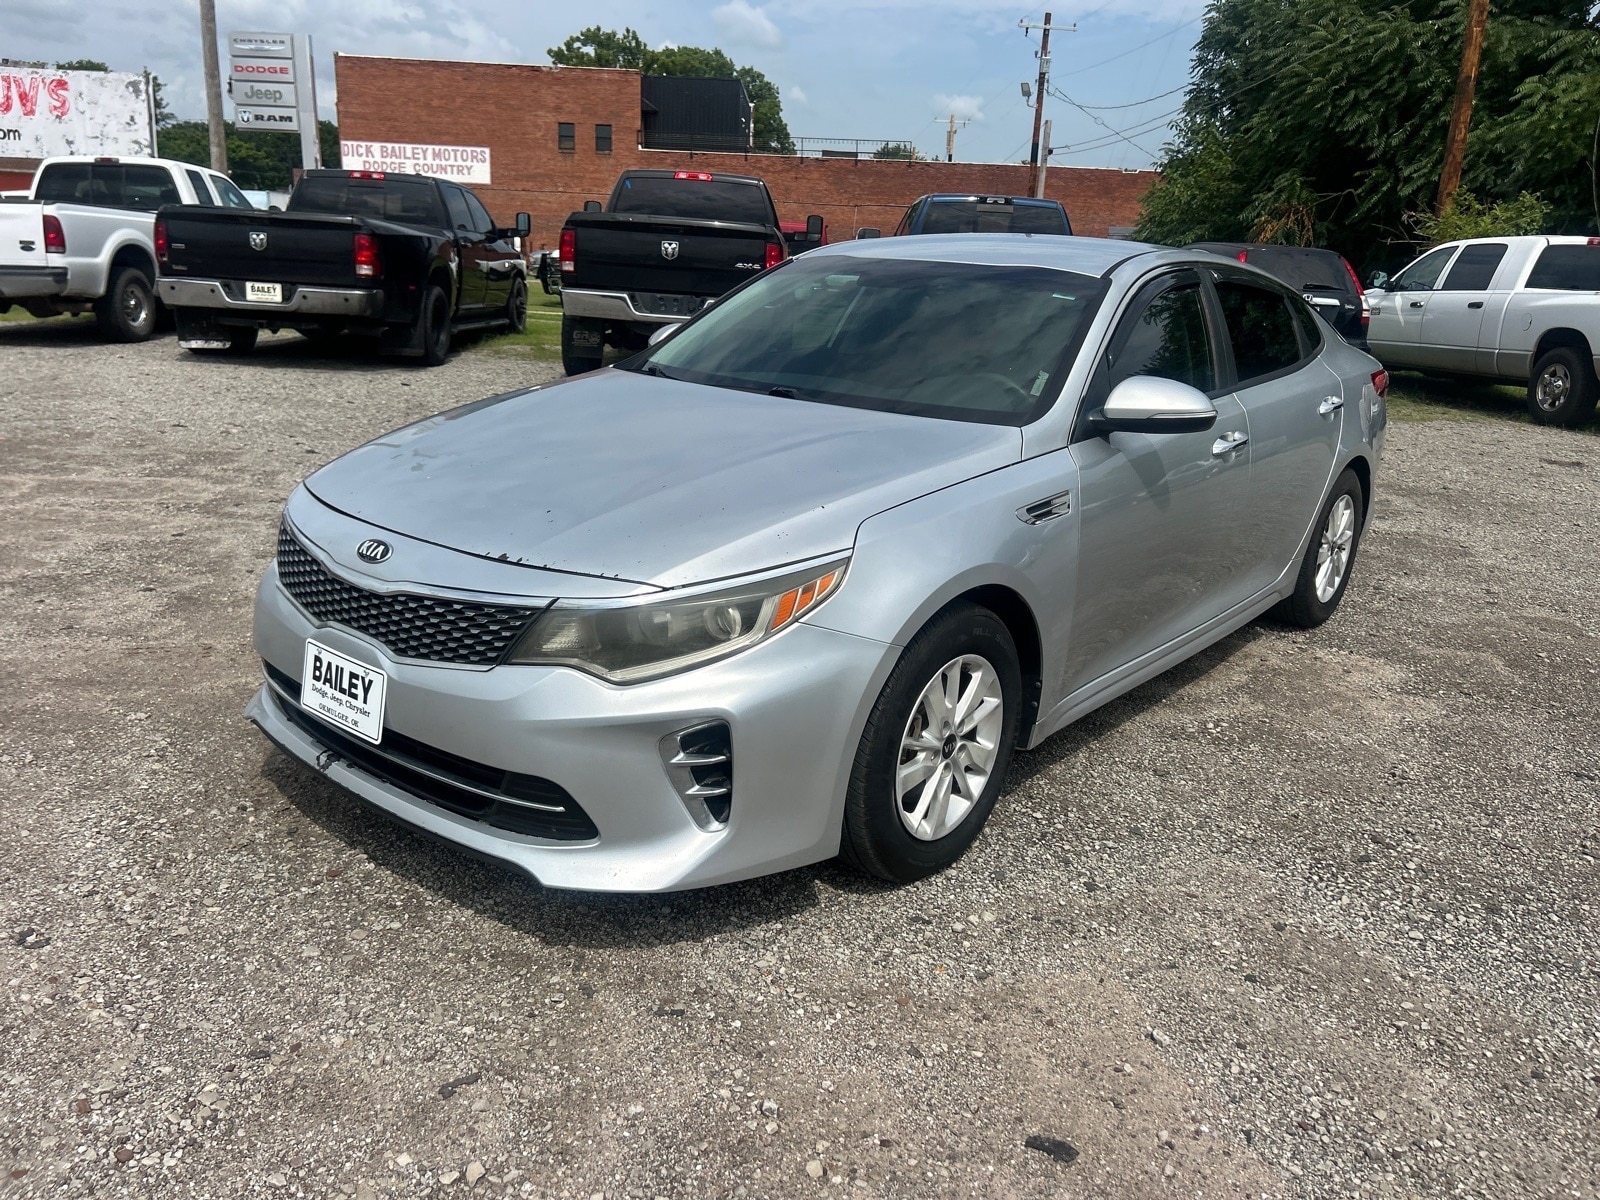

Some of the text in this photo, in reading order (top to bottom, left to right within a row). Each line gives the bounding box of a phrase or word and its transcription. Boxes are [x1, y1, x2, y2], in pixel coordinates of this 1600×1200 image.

[234, 65, 289, 74] DODGE
[244, 85, 283, 103] Jeep
[254, 114, 293, 123] RAM
[342, 143, 487, 164] DICK BAILEY MOTORS
[363, 160, 473, 175] DODGE COUNTRY
[251, 285, 277, 294] BAILEY
[359, 540, 385, 560] KIA
[312, 654, 374, 705] BAILEY
[345, 700, 371, 718] Chrysler
[350, 718, 360, 728] OK
